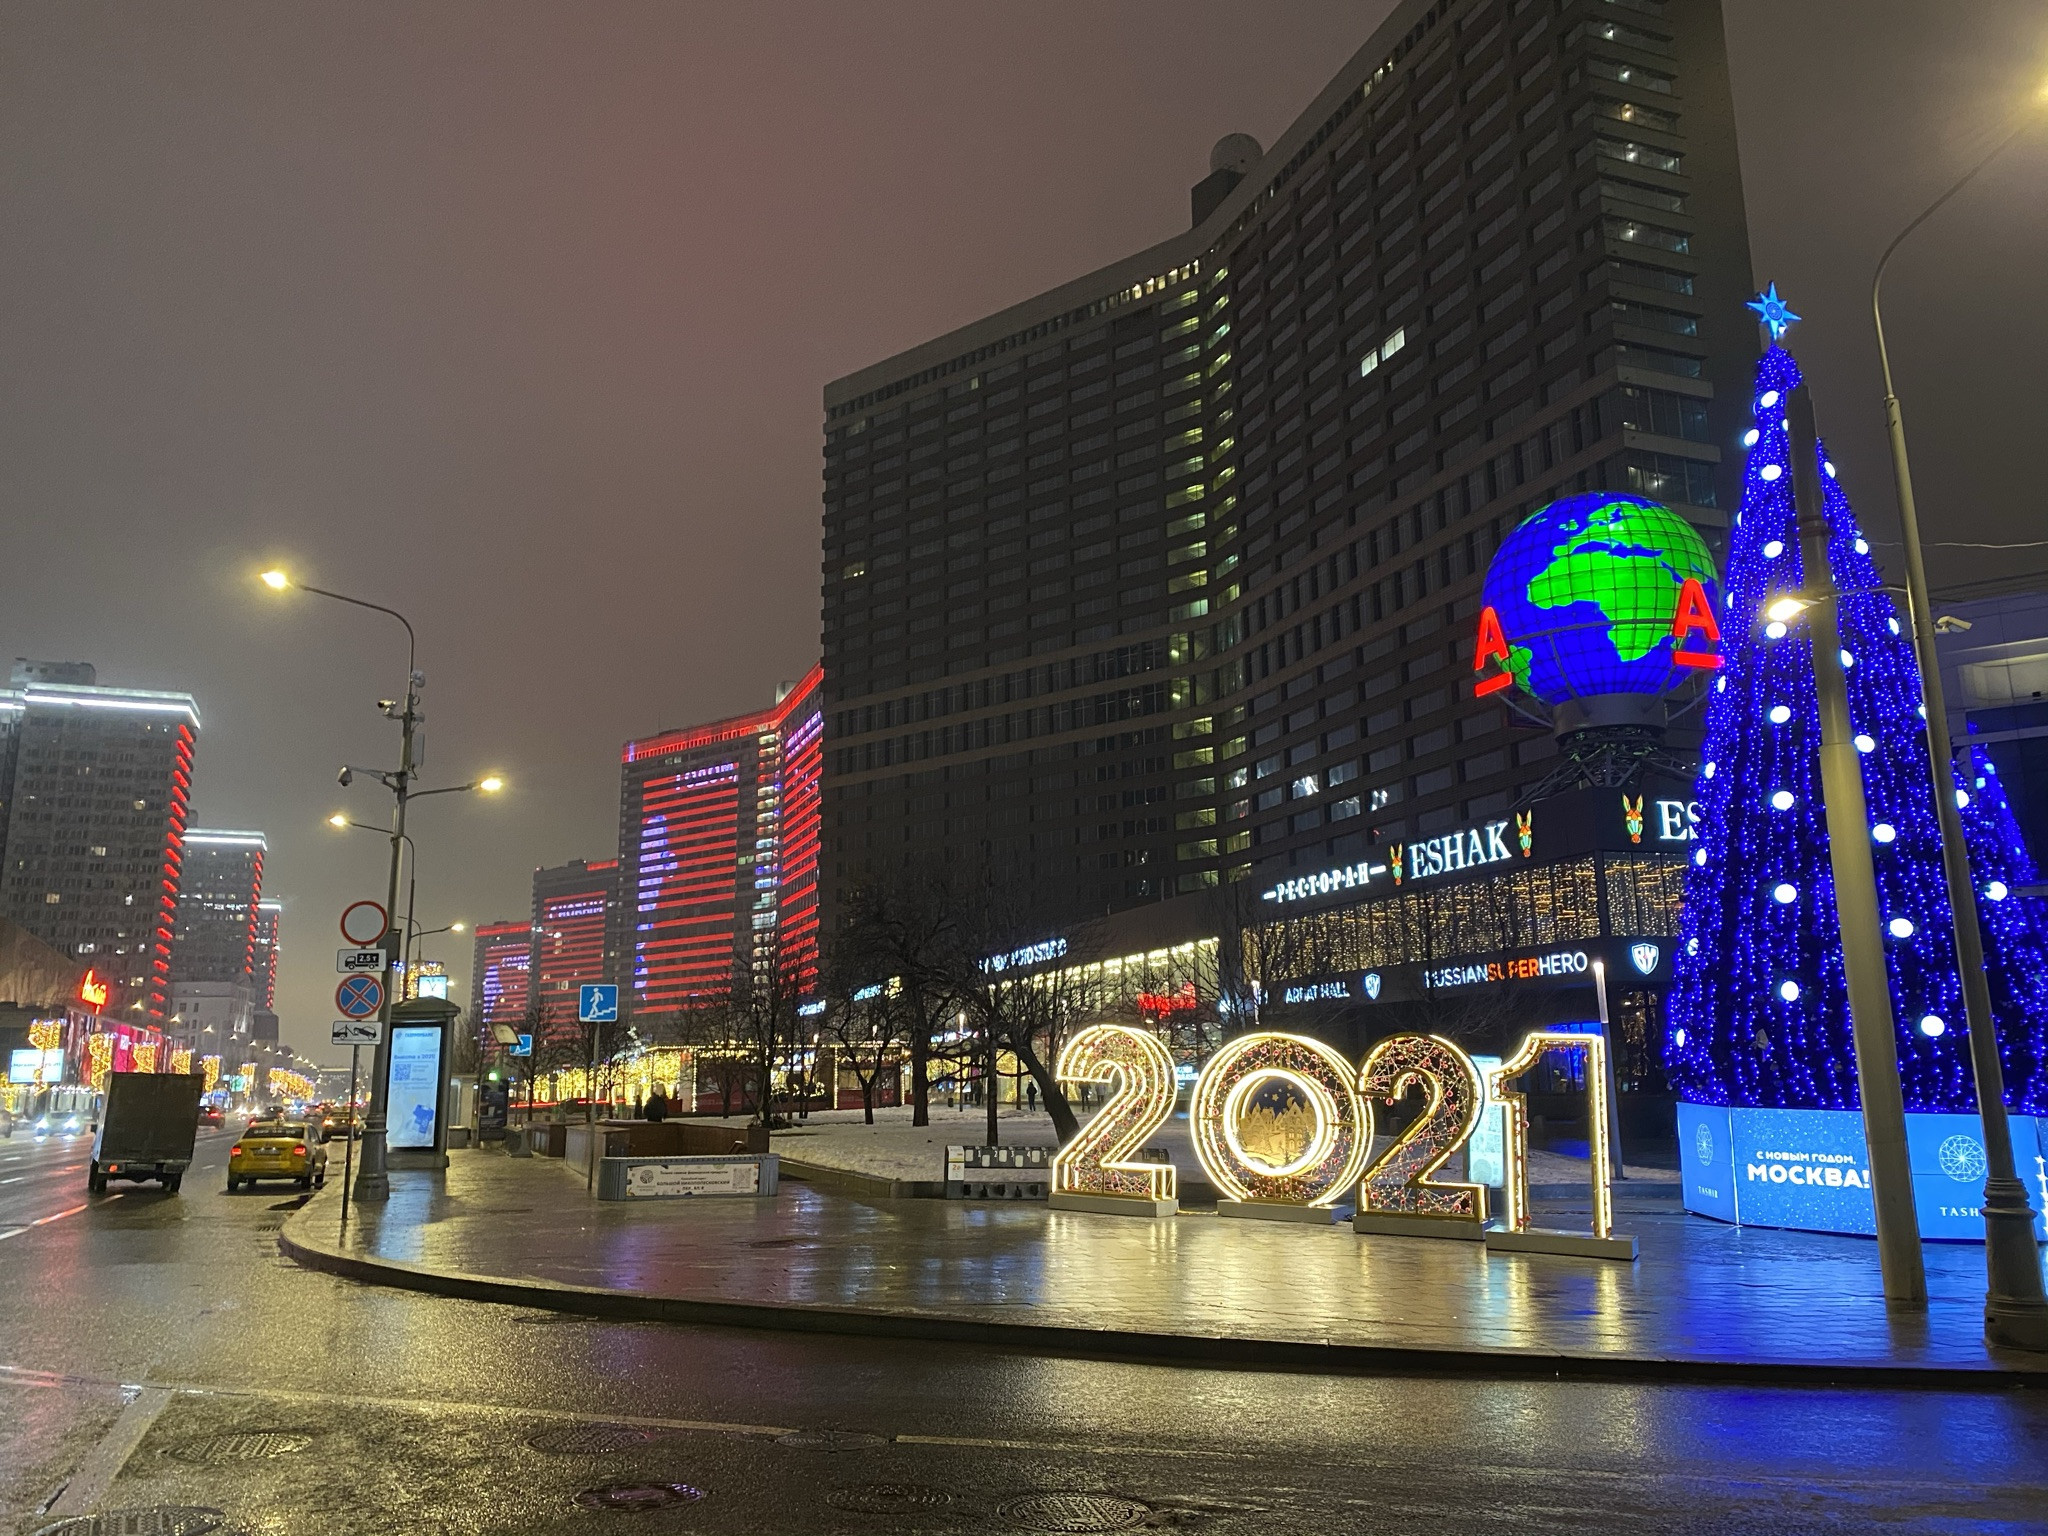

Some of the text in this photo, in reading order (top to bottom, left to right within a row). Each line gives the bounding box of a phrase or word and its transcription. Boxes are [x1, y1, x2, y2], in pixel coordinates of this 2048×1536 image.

[1408, 821, 1512, 879] ESHAK
[1053, 1024, 1612, 1239] 2021
[1747, 1163, 1870, 1190] МОСКВА!
[1756, 1151, 1857, 1166] С НОВЫМ ГОДОМ,
